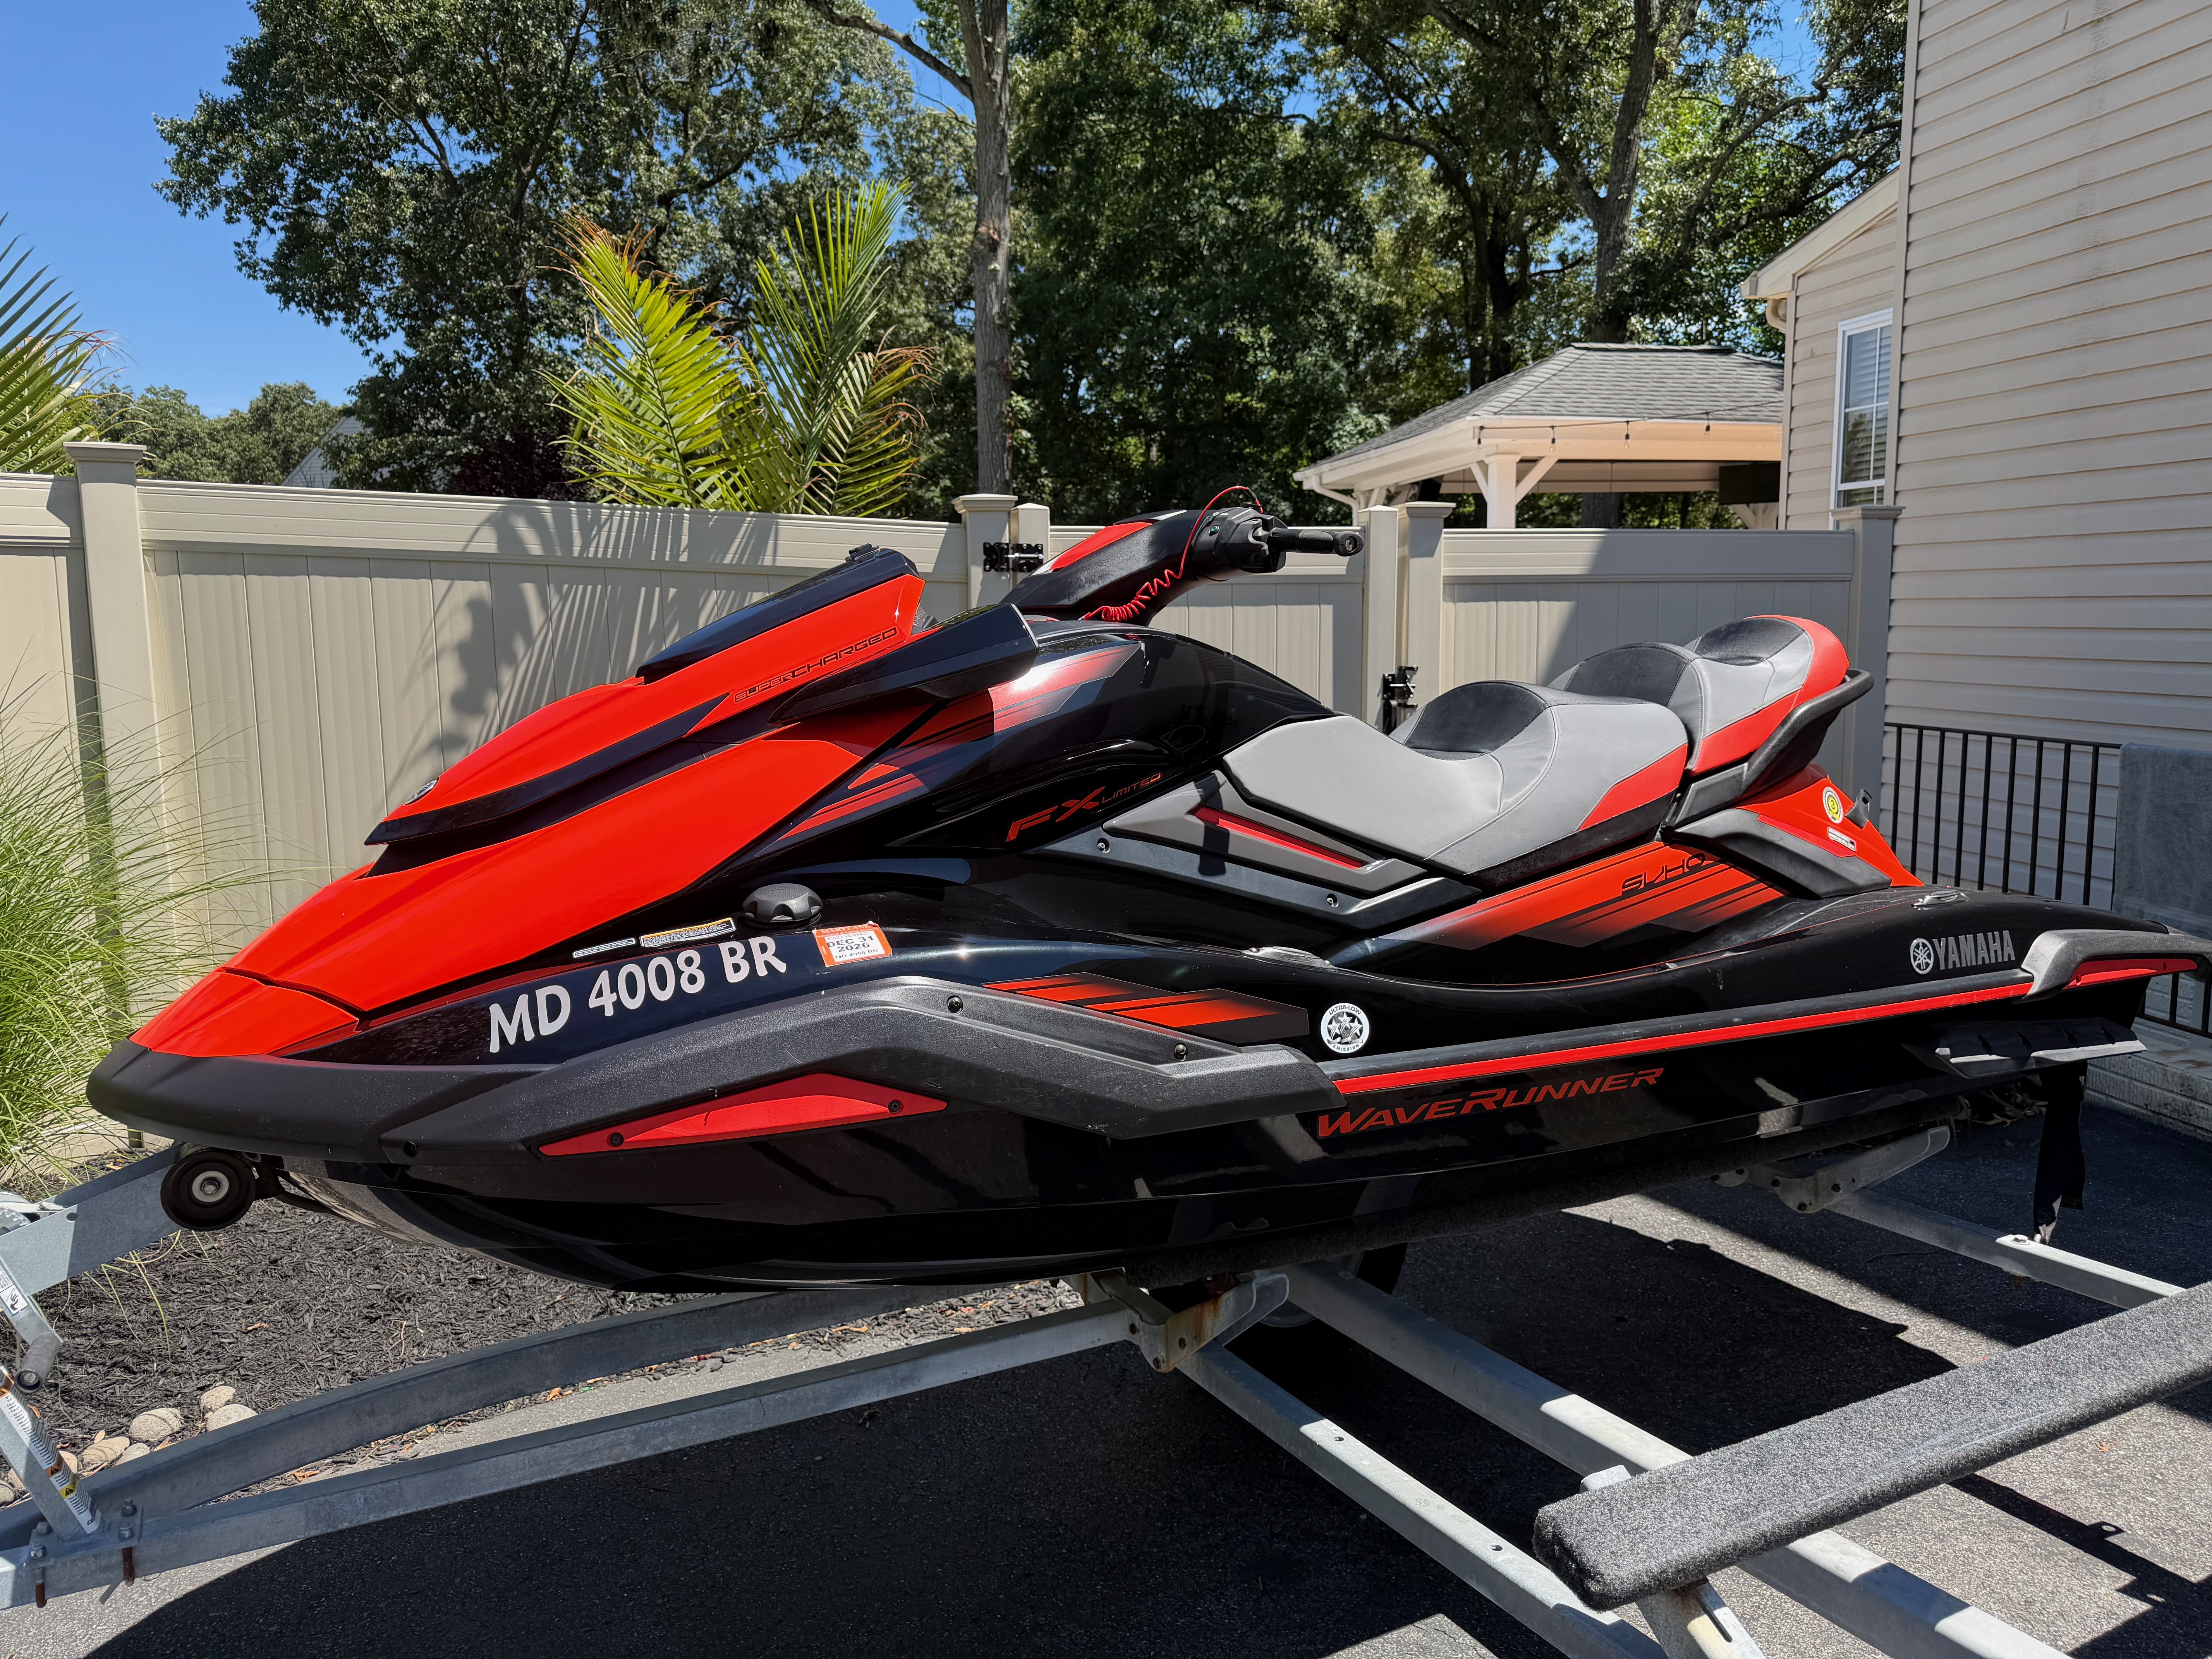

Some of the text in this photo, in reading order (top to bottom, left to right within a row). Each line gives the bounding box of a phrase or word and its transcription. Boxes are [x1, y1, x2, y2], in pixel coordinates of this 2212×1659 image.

[735, 627, 897, 703] SUPERCHARGED
[1006, 773, 1162, 842] FX LIMITED
[827, 939, 854, 948] DEC
[837, 943, 870, 952] 2026
[1932, 930, 2015, 970] YAMAHA
[489, 936, 787, 1053] MD 4008 BR
[1329, 1005, 1361, 1015] ULTRA-LOW
